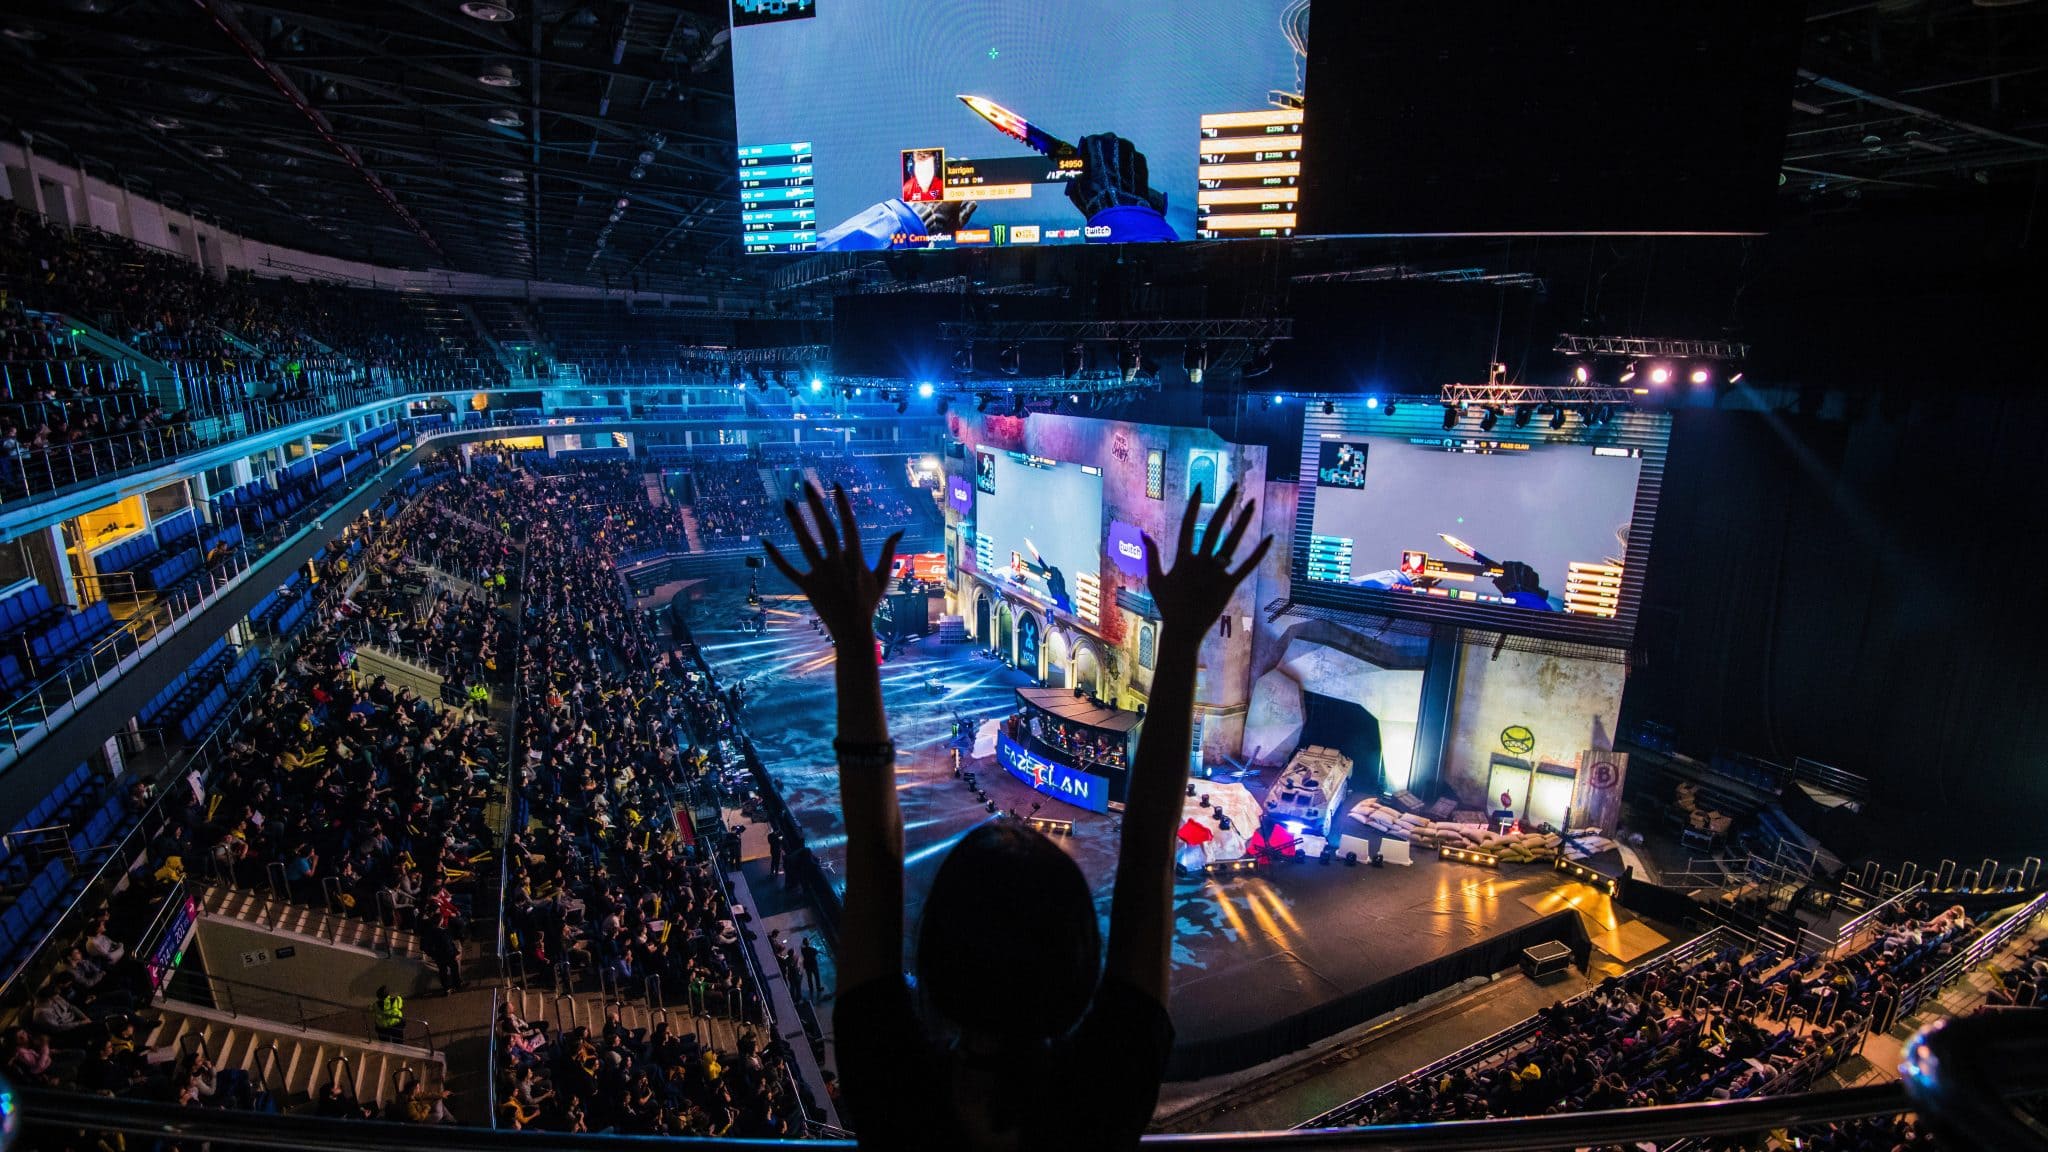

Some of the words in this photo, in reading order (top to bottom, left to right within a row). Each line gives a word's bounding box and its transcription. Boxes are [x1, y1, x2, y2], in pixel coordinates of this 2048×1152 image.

[947, 166, 975, 175] karrigan
[1059, 160, 1083, 169] $4950
[1085, 226, 1111, 238] twitch
[1119, 541, 1142, 559] twitch
[1597, 766, 1610, 782] B
